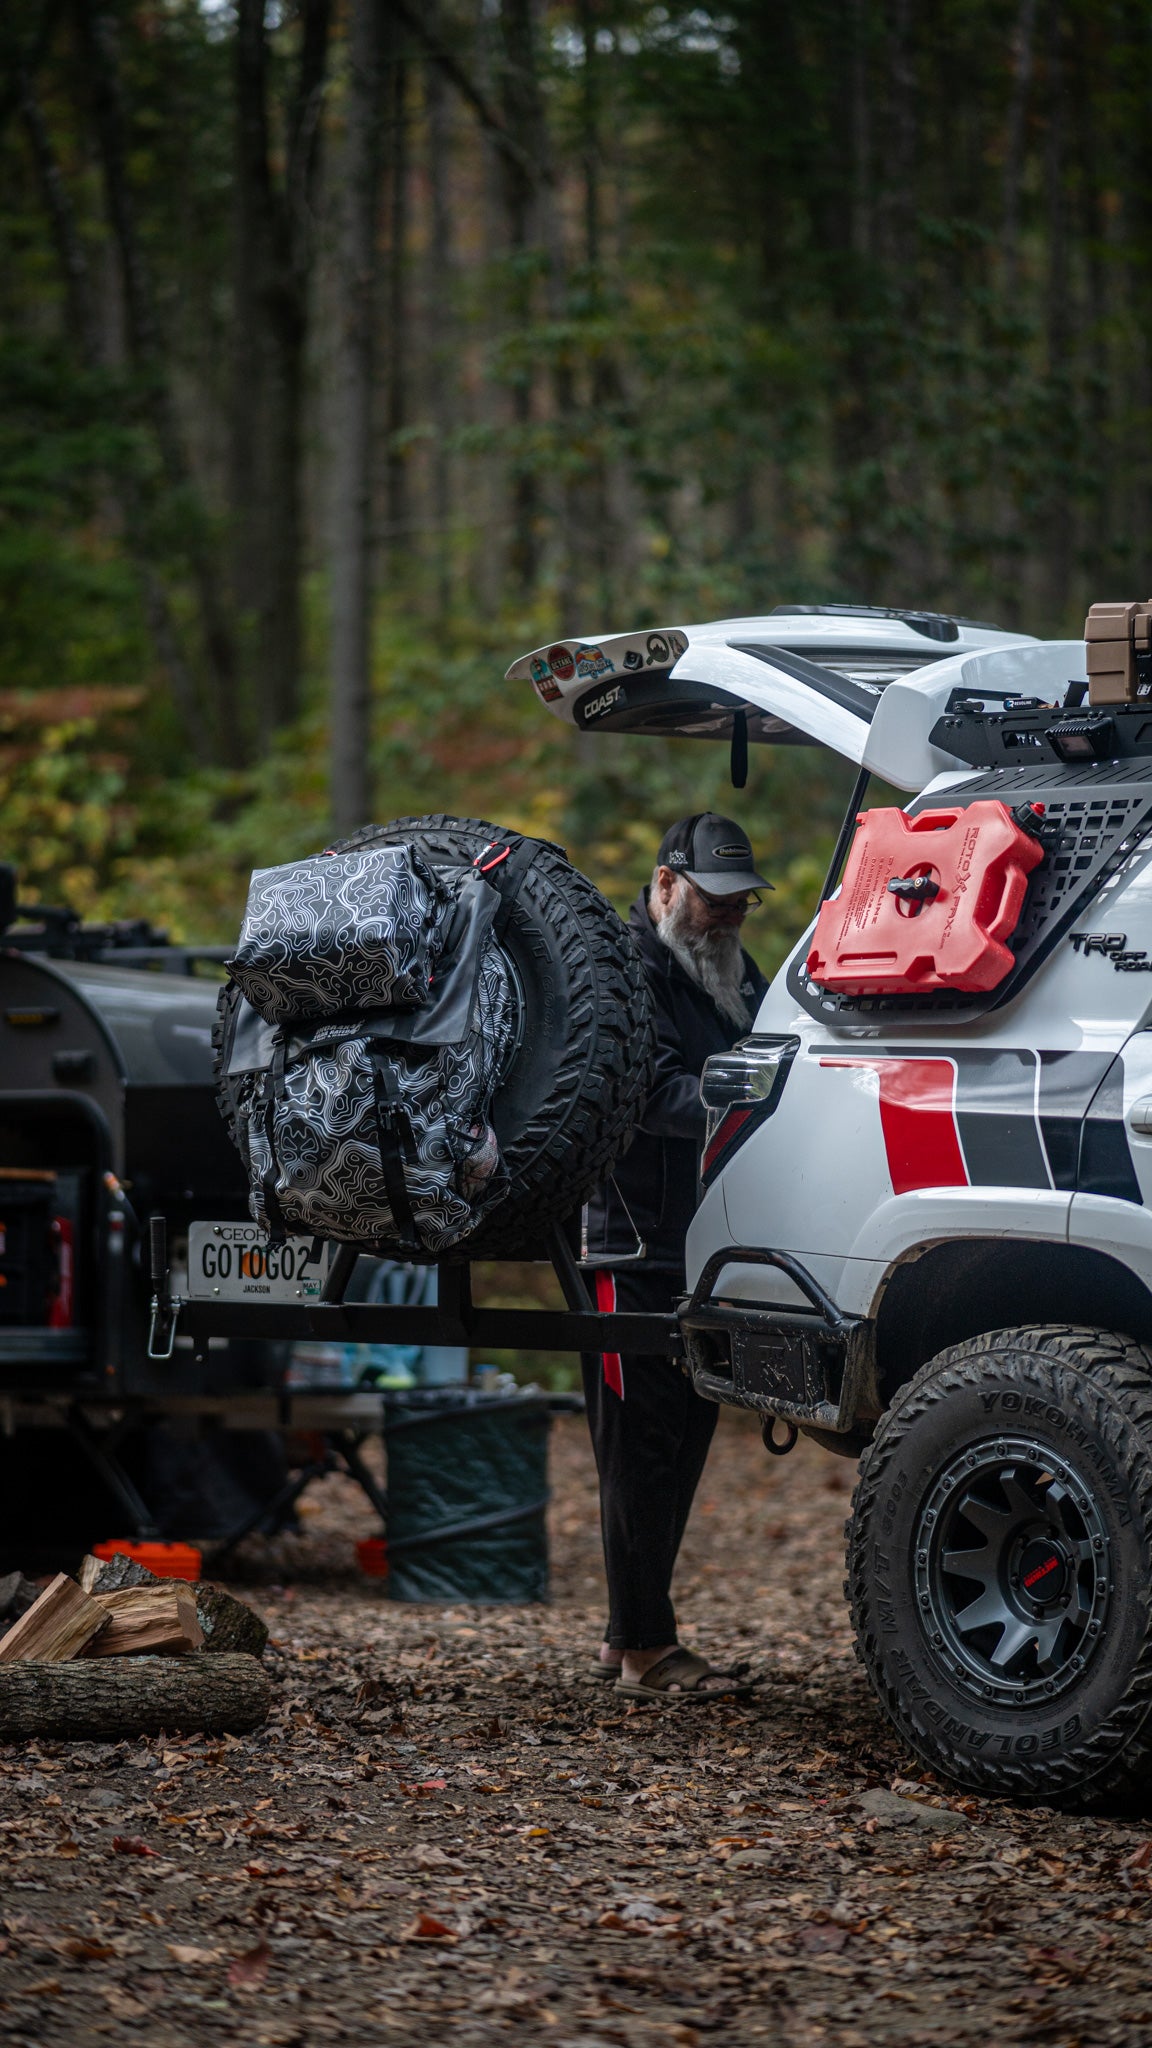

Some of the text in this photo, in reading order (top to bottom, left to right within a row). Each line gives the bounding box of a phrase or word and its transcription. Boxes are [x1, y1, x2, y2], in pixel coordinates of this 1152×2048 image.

[584, 686, 621, 719] COAST
[961, 827, 979, 872] ROTO
[871, 856, 894, 924] GASOLINE
[1068, 932, 1127, 957] TRD
[1109, 951, 1148, 962] OFF
[1114, 961, 1152, 972] ROA
[221, 1227, 295, 1242] GEOR
[202, 1243, 311, 1281] GOTOGO2
[243, 1284, 271, 1294] JACKSON
[979, 1389, 1132, 1528] YOKOHAMA
[873, 1542, 899, 1634] M/T
[890, 1648, 1083, 1757] GEOLANDAR
